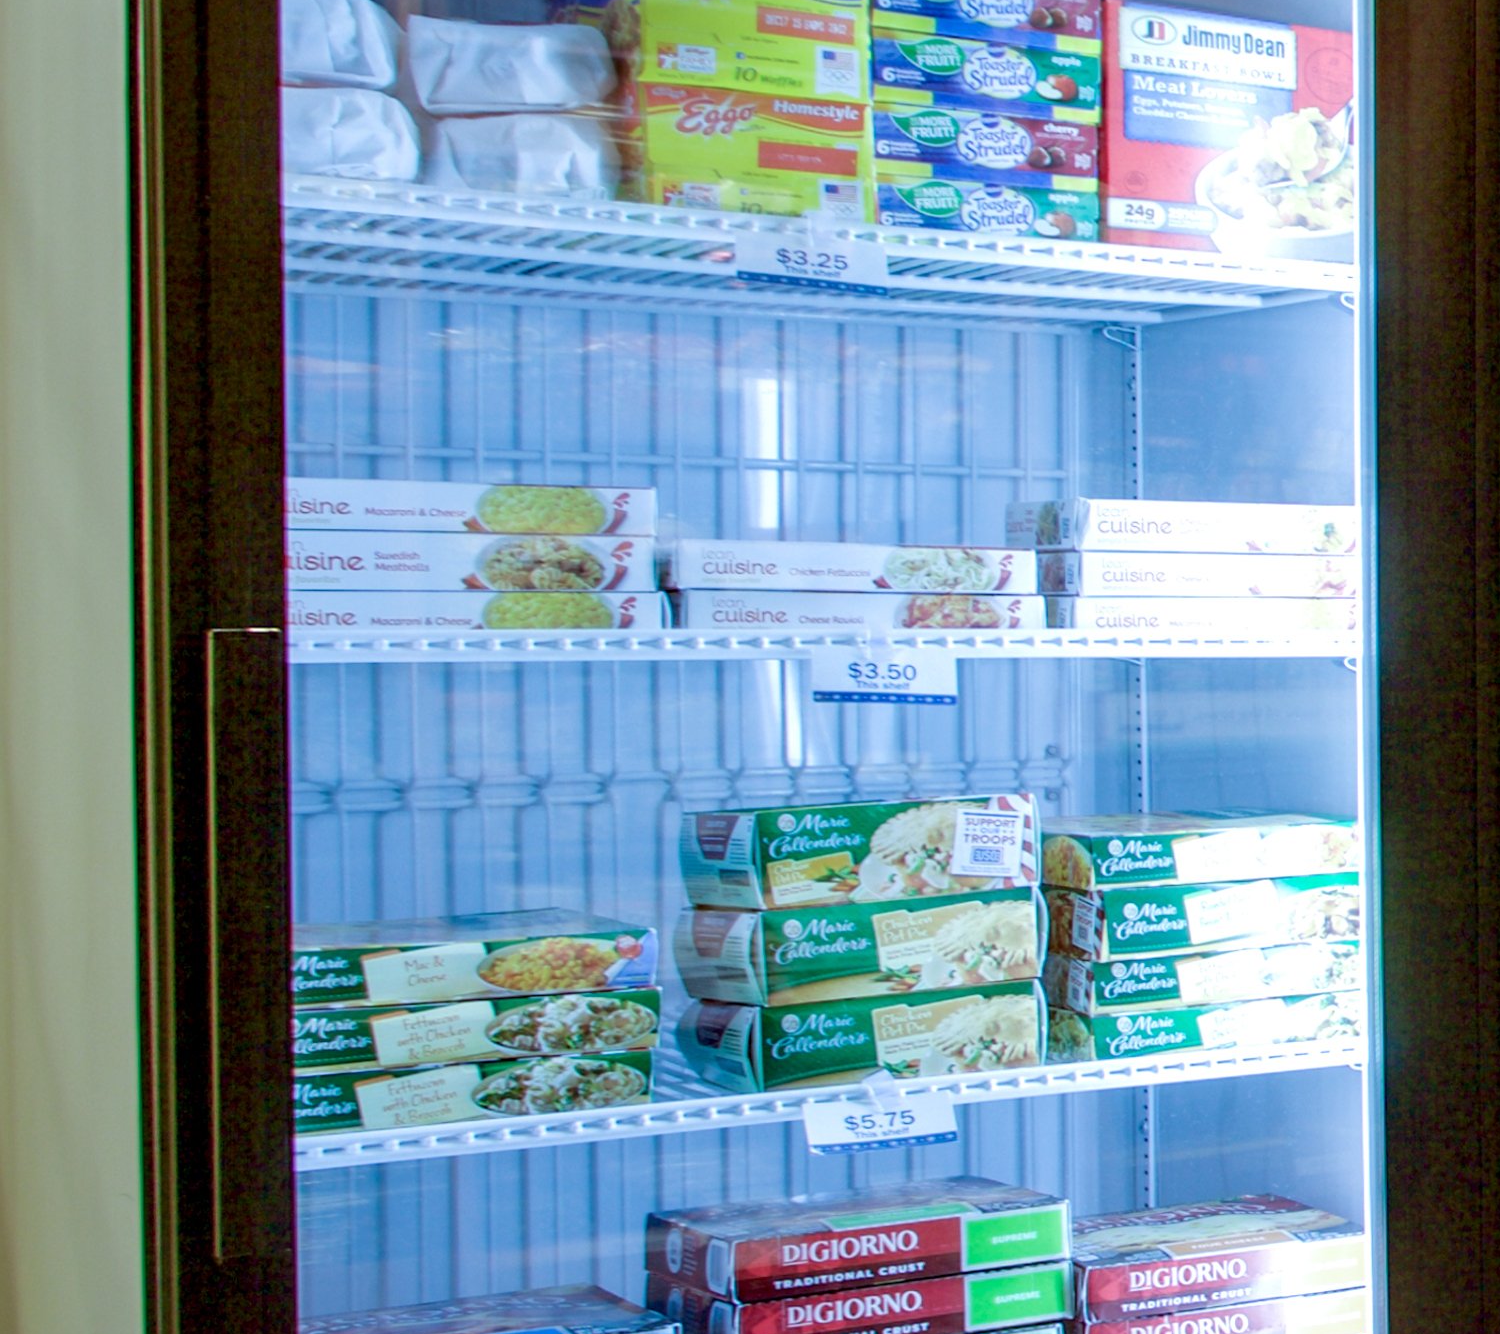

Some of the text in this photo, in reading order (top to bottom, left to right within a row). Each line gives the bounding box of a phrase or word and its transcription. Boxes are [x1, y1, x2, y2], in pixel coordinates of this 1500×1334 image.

[1182, 25, 1287, 58] Jimmy Dean
[735, 66, 759, 83] 10
[978, 58, 1024, 74] Toaster
[970, 70, 1031, 90] Strudel
[1132, 75, 1187, 95] Meat
[675, 91, 756, 137] Eggo
[773, 97, 860, 124] Homestyle
[964, 127, 1014, 144] Toaster
[957, 140, 1024, 161] Strudel
[1124, 204, 1155, 222] 24g
[776, 246, 849, 272] $3.25
[365, 507, 417, 518] Macaroni
[1097, 516, 1173, 536] cuisine
[374, 551, 421, 561] Swedish
[702, 557, 779, 577] cuisine
[1101, 568, 1167, 584] cuisine
[371, 616, 422, 626] Macaroni
[712, 605, 788, 624] cuisine
[848, 661, 917, 682] $3.50
[797, 814, 850, 835] Marie
[965, 817, 1016, 828] SUPPORT
[762, 829, 865, 859] Callender's
[963, 833, 1016, 846] TROOPS
[1123, 839, 1164, 859] Marie
[1096, 854, 1174, 879] Callender's
[803, 919, 857, 938] Marie
[774, 933, 871, 965] Callender's
[801, 1014, 857, 1034] Marie
[767, 1028, 869, 1060] Callender's
[844, 1108, 917, 1133] $5.75
[774, 1261, 926, 1291] TRADITIONAL CRUST
